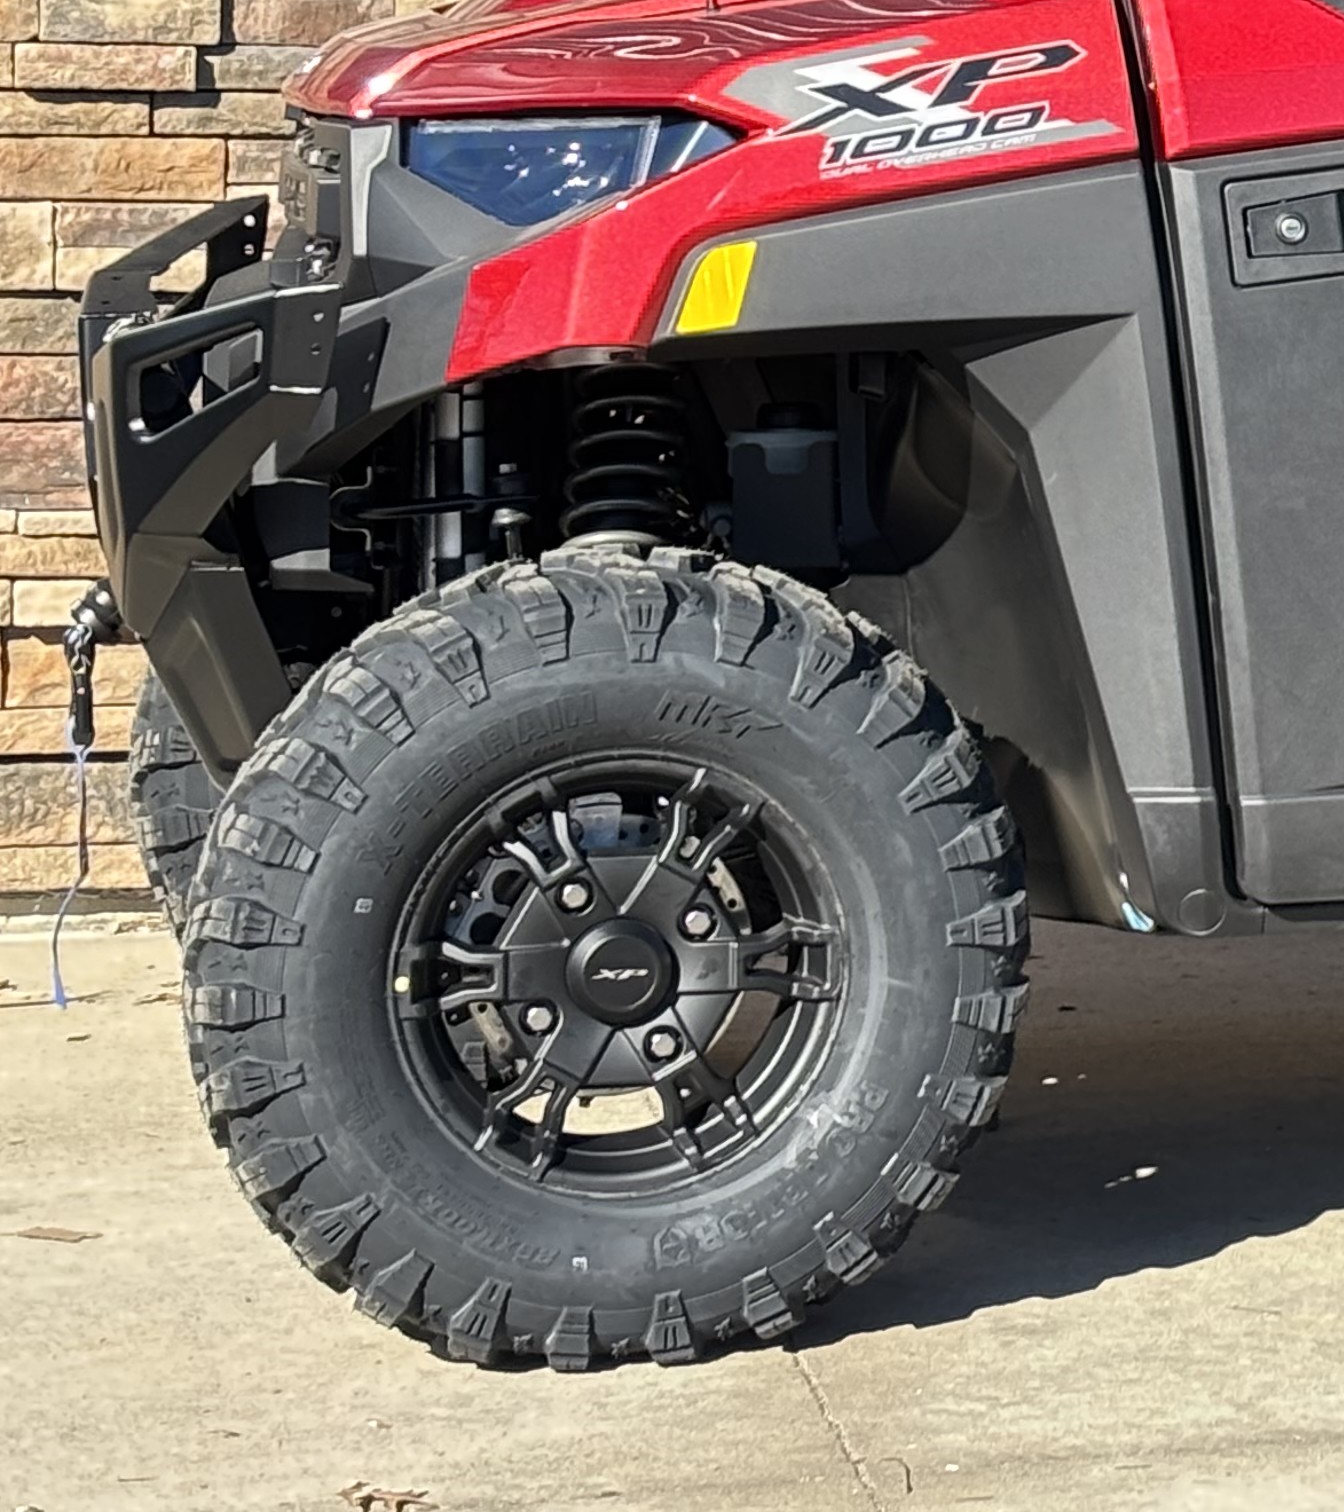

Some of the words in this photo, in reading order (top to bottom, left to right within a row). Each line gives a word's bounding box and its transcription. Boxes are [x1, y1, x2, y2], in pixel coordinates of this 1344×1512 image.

[770, 41, 1087, 139] XP
[819, 161, 874, 180] DUAL
[876, 143, 987, 170] OVERHEAD
[989, 133, 1037, 150] CAM
[820, 102, 1051, 169] 1000
[355, 690, 600, 876] X-TERRAIN
[591, 968, 649, 981] XP
